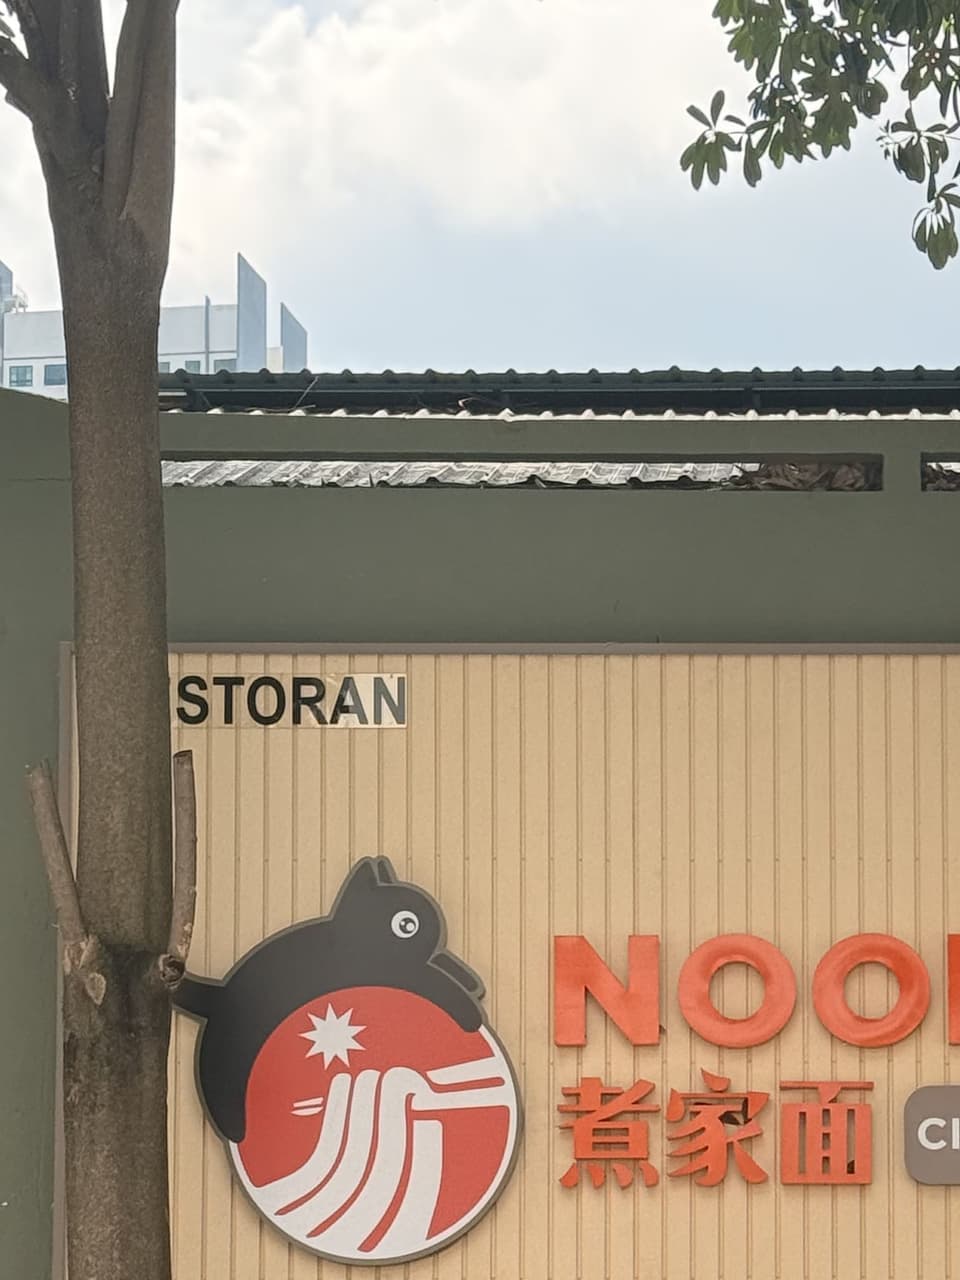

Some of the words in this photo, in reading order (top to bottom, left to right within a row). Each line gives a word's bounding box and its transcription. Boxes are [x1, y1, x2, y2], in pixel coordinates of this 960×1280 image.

[175, 674, 407, 726] STORAN
[557, 1067, 875, 1190] 煮家面
